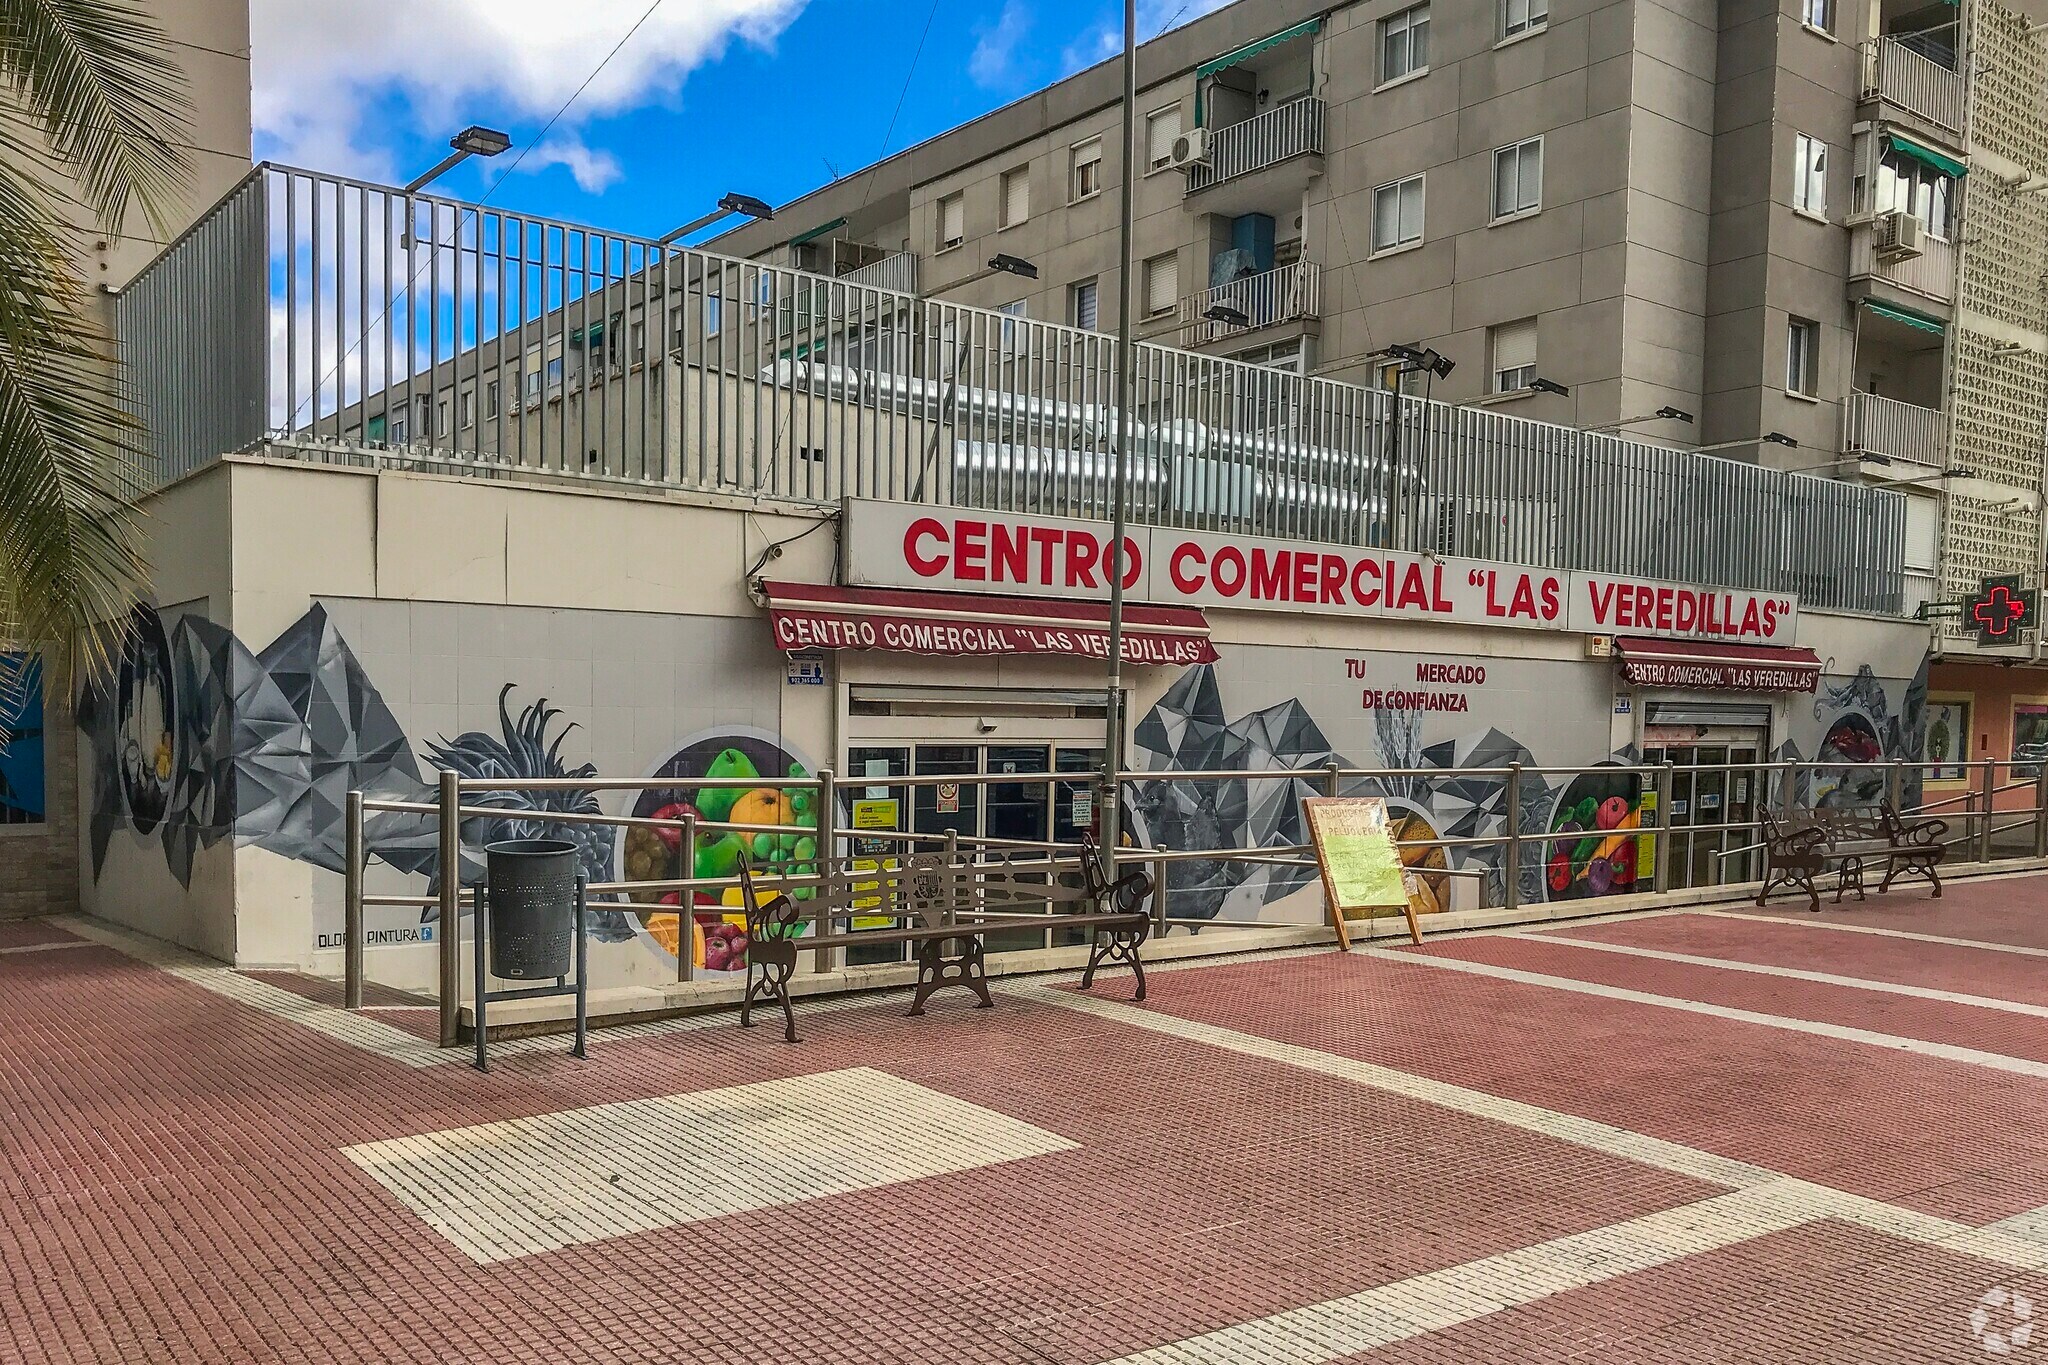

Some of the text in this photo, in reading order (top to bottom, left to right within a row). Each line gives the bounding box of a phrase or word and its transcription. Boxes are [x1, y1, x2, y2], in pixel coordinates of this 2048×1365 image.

[903, 517, 1790, 638] CENTRO COMERCIAL “LAS VEREDILLAS”
[778, 617, 876, 645] CENTRO
[883, 623, 1015, 650] COMERCIAL
[1015, 628, 1073, 650] “LAS
[1345, 659, 1486, 684] TU MERCADO
[1626, 662, 1664, 683] CENTRO
[1668, 667, 1724, 685] COMERCIAL
[1363, 690, 1468, 712] DE CONFIANZA
[367, 929, 420, 944] PINTURA
